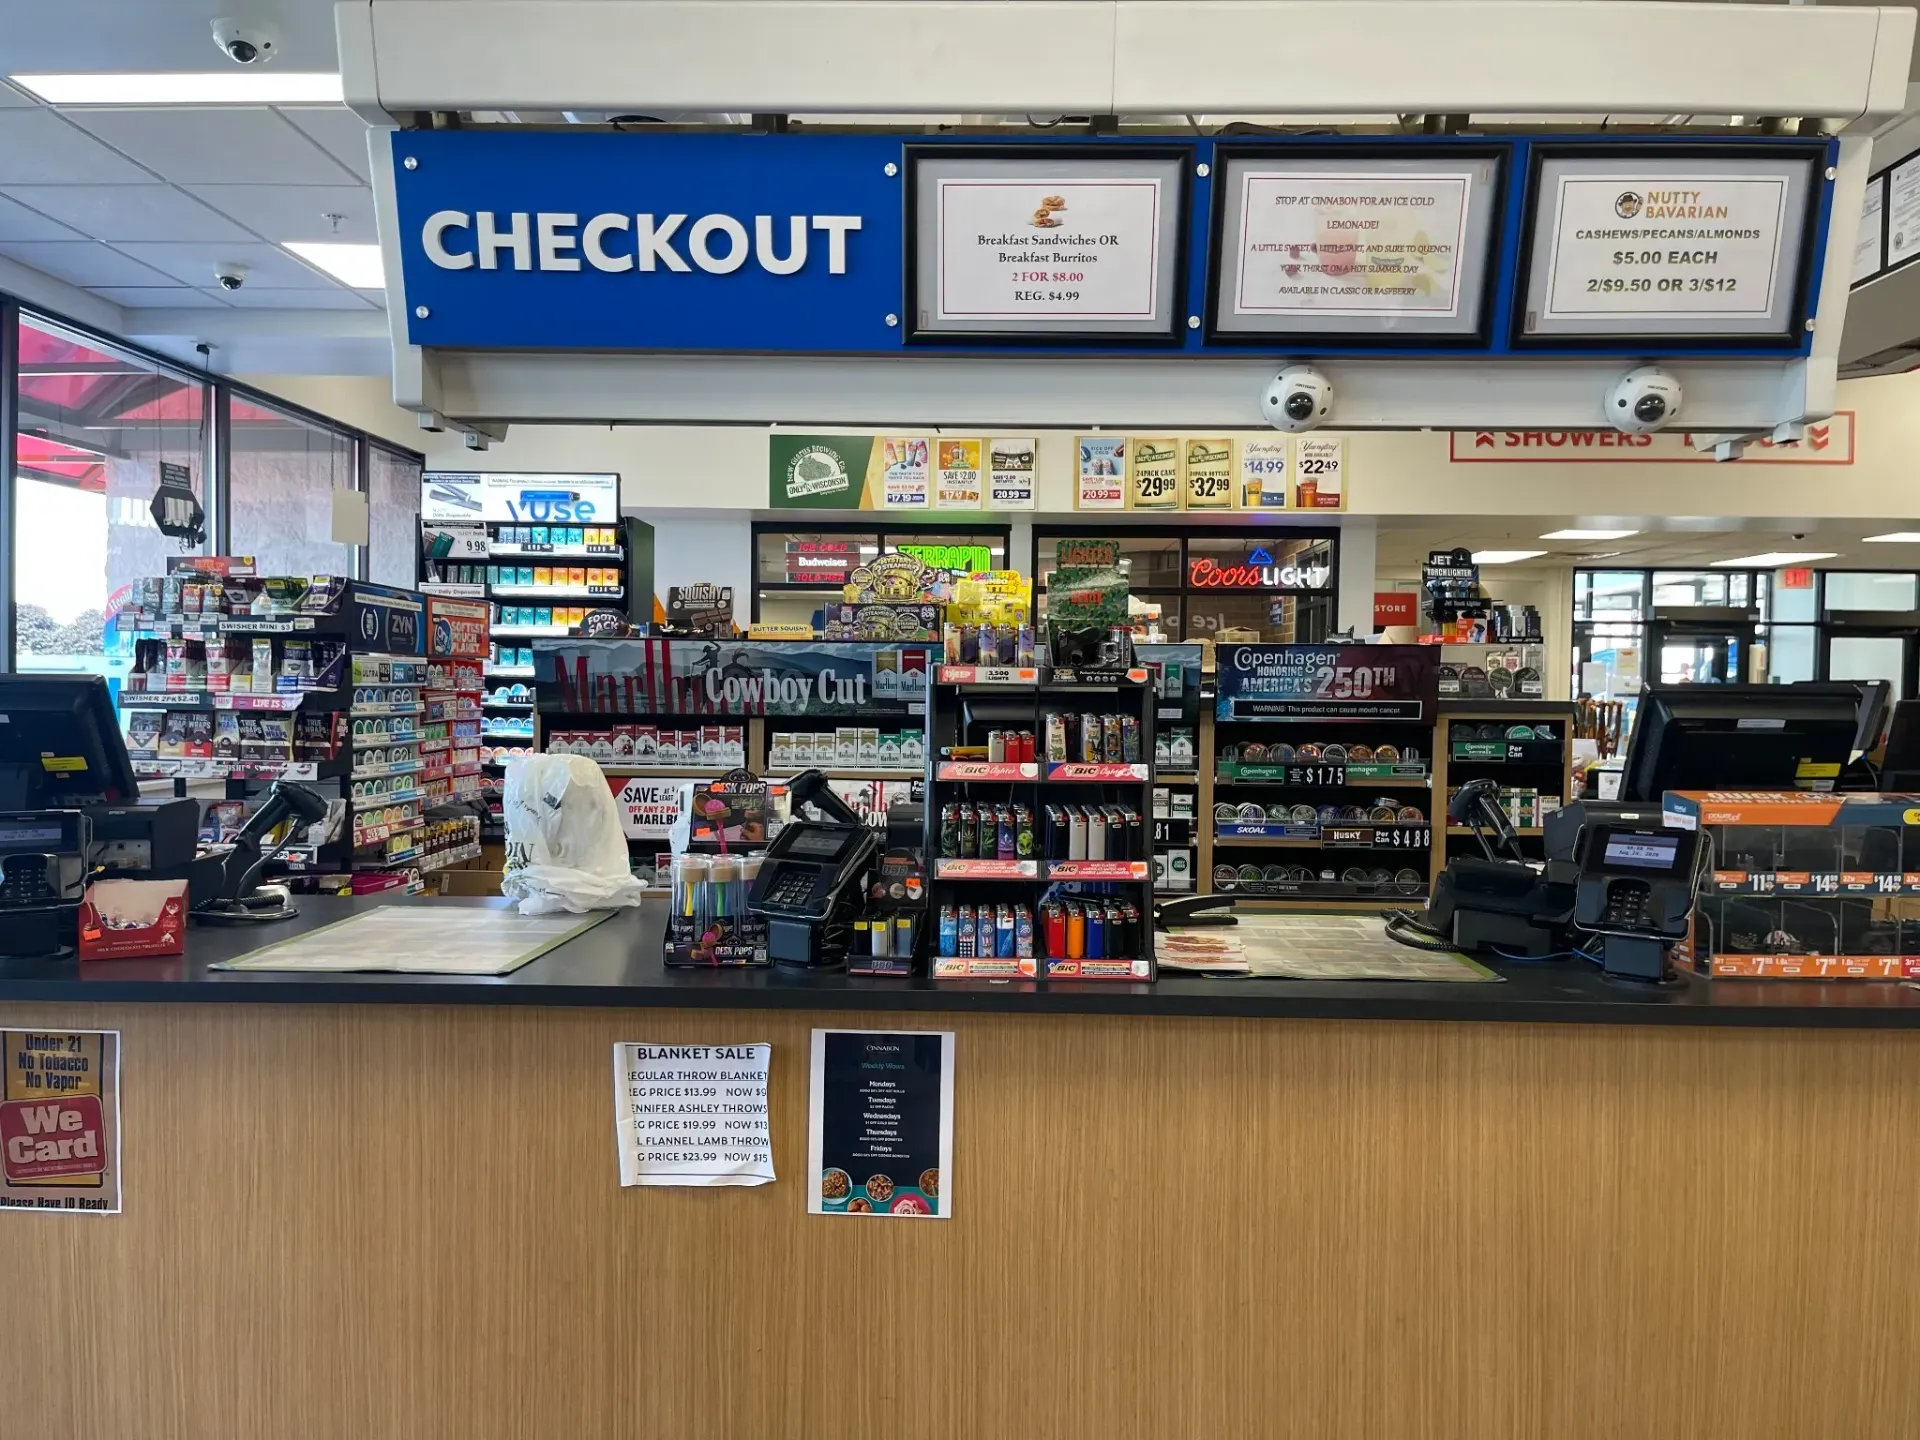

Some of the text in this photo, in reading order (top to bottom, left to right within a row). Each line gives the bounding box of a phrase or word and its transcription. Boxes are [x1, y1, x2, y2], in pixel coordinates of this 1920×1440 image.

[1275, 196, 1434, 206] STOP AT CINNABON FOR AN ICE COLD
[1648, 191, 1701, 204] NUTTY
[1645, 206, 1728, 219] BAVARIAN
[1327, 220, 1379, 230] LEMONADE!
[1576, 229, 1760, 239] CASHEWS/PECANS/ALMONDS
[422, 210, 862, 275] CHECKOUT
[978, 234, 1119, 246] Breakfast Sandwiches OR
[1251, 244, 1257, 252] A
[1366, 244, 1383, 253] AND
[1385, 244, 1404, 253] SURE
[1406, 245, 1416, 253] TO
[1418, 245, 1451, 253] QUENCH
[998, 252, 1098, 263] Breakfast Burritos
[1613, 251, 1717, 265] $5.00 EACH
[1303, 264, 1329, 273] THIRST
[1351, 265, 1367, 273] HOT
[1403, 265, 1419, 274] DAY
[1012, 272, 1084, 282] 2 FOR $8.00
[1587, 278, 1736, 293] 2/$9.50 OR 3/$12
[1015, 291, 1080, 301] REG. $4.99
[1278, 287, 1416, 296] AVAILABLE IN CLASSIC OR RASPBERRY
[1505, 432, 1652, 447] SHOWERS
[1244, 461, 1284, 473] $14.99
[943, 471, 958, 480] SAVE
[798, 543, 847, 552] ICE COLD
[798, 557, 848, 567] Budweiser
[1431, 555, 1452, 566] JET
[1190, 559, 1326, 587] Coors LIGHT
[1448, 568, 1472, 577] LIGHTER
[678, 587, 721, 600] SQUISHY
[588, 614, 619, 624] FOOTY
[281, 623, 291, 631] $3
[392, 615, 413, 634] ZYN
[451, 621, 484, 633] SOFTEST
[588, 623, 619, 637] SACK
[1234, 647, 1336, 674] Copenhagen
[1257, 666, 1303, 677] HONORING
[1241, 677, 1313, 693] AMERICA'S
[1316, 667, 1396, 699] 250TH
[707, 667, 866, 713] Cowboy Cut
[160, 694, 177, 702] 2PK
[177, 694, 199, 702] $2.49
[252, 699, 281, 708] LIFE IS
[1287, 705, 1301, 713] This
[1301, 705, 1324, 714] product
[191, 714, 208, 722] TRUE
[240, 719, 257, 727] TRUE
[188, 721, 211, 729] WRAPS
[239, 726, 262, 734] WRAPS
[964, 766, 987, 775] BIC
[1073, 766, 1098, 775] BIC
[1240, 766, 1277, 777] Copenhagen
[740, 783, 766, 793] POPS
[624, 787, 659, 803] SAVE
[1236, 826, 1267, 835] SKOAL
[1333, 830, 1361, 841] HUSKY
[1056, 865, 1077, 873] BIC
[715, 946, 753, 955] DESK POPS
[1056, 964, 1077, 972] BIC
[25, 1034, 82, 1053] Under 21
[637, 1048, 755, 1060] BLANKET SALE
[18, 1052, 88, 1072] No Tobacco
[861, 1062, 884, 1071] Weekly
[677, 1072, 717, 1080] THROW
[25, 1071, 82, 1092] No Vapor
[649, 1088, 753, 1097] PRICE $13.99 NOW
[678, 1104, 719, 1113] ASHLEY
[20, 1105, 83, 1135] We
[863, 1112, 901, 1120] Wednesdays
[648, 1121, 680, 1129] PRICE
[683, 1121, 716, 1130] $19.99
[724, 1121, 752, 1129] NOW
[646, 1137, 769, 1146] FLANNEL LAMB THROW
[8, 1130, 98, 1164] Card
[870, 1145, 892, 1153] Fridays
[648, 1153, 768, 1163] PRICE $23.99 NOW $15
[0, 1196, 108, 1210] Please Have ID Ready
